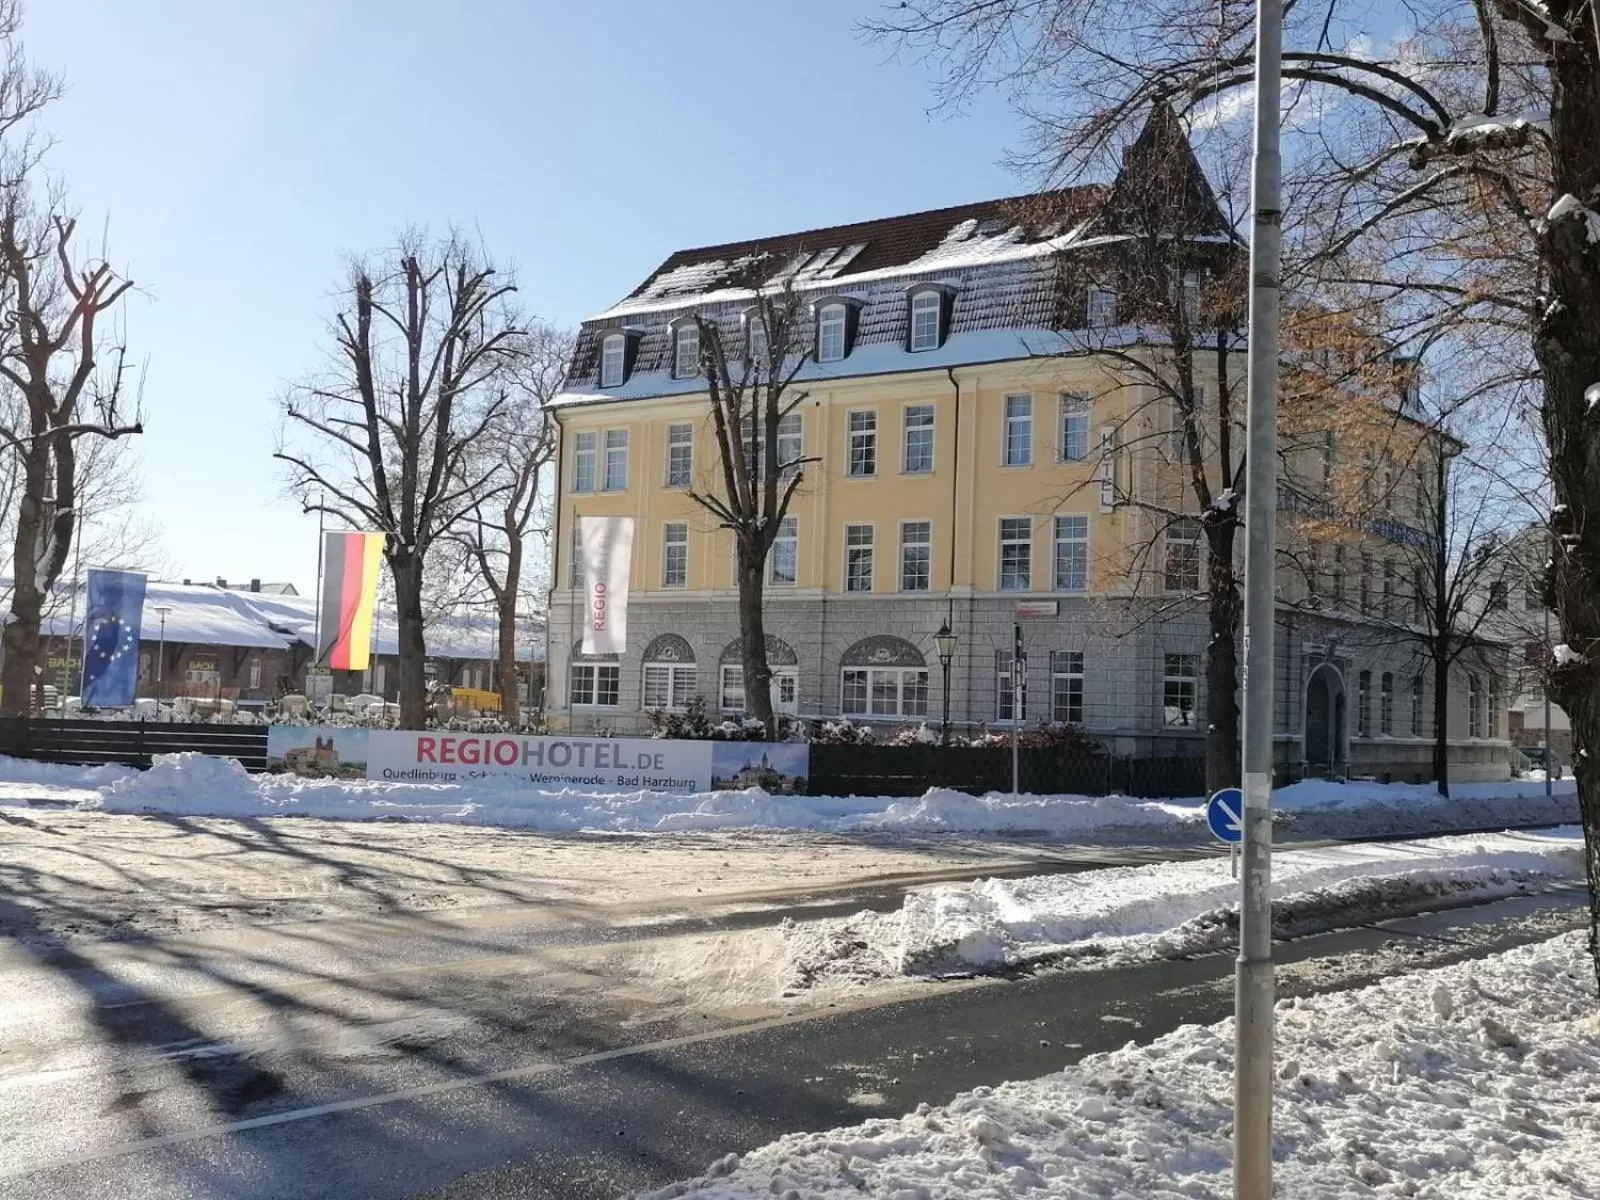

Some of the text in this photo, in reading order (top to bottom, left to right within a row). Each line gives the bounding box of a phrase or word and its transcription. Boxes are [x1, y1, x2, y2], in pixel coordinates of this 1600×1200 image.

[1101, 432, 1114, 507] HOTEL
[593, 582, 607, 632] REGIO
[416, 736, 665, 770] REGIOHOTEL.DE
[617, 775, 639, 787] Bad
[643, 775, 697, 791] Harzburg
